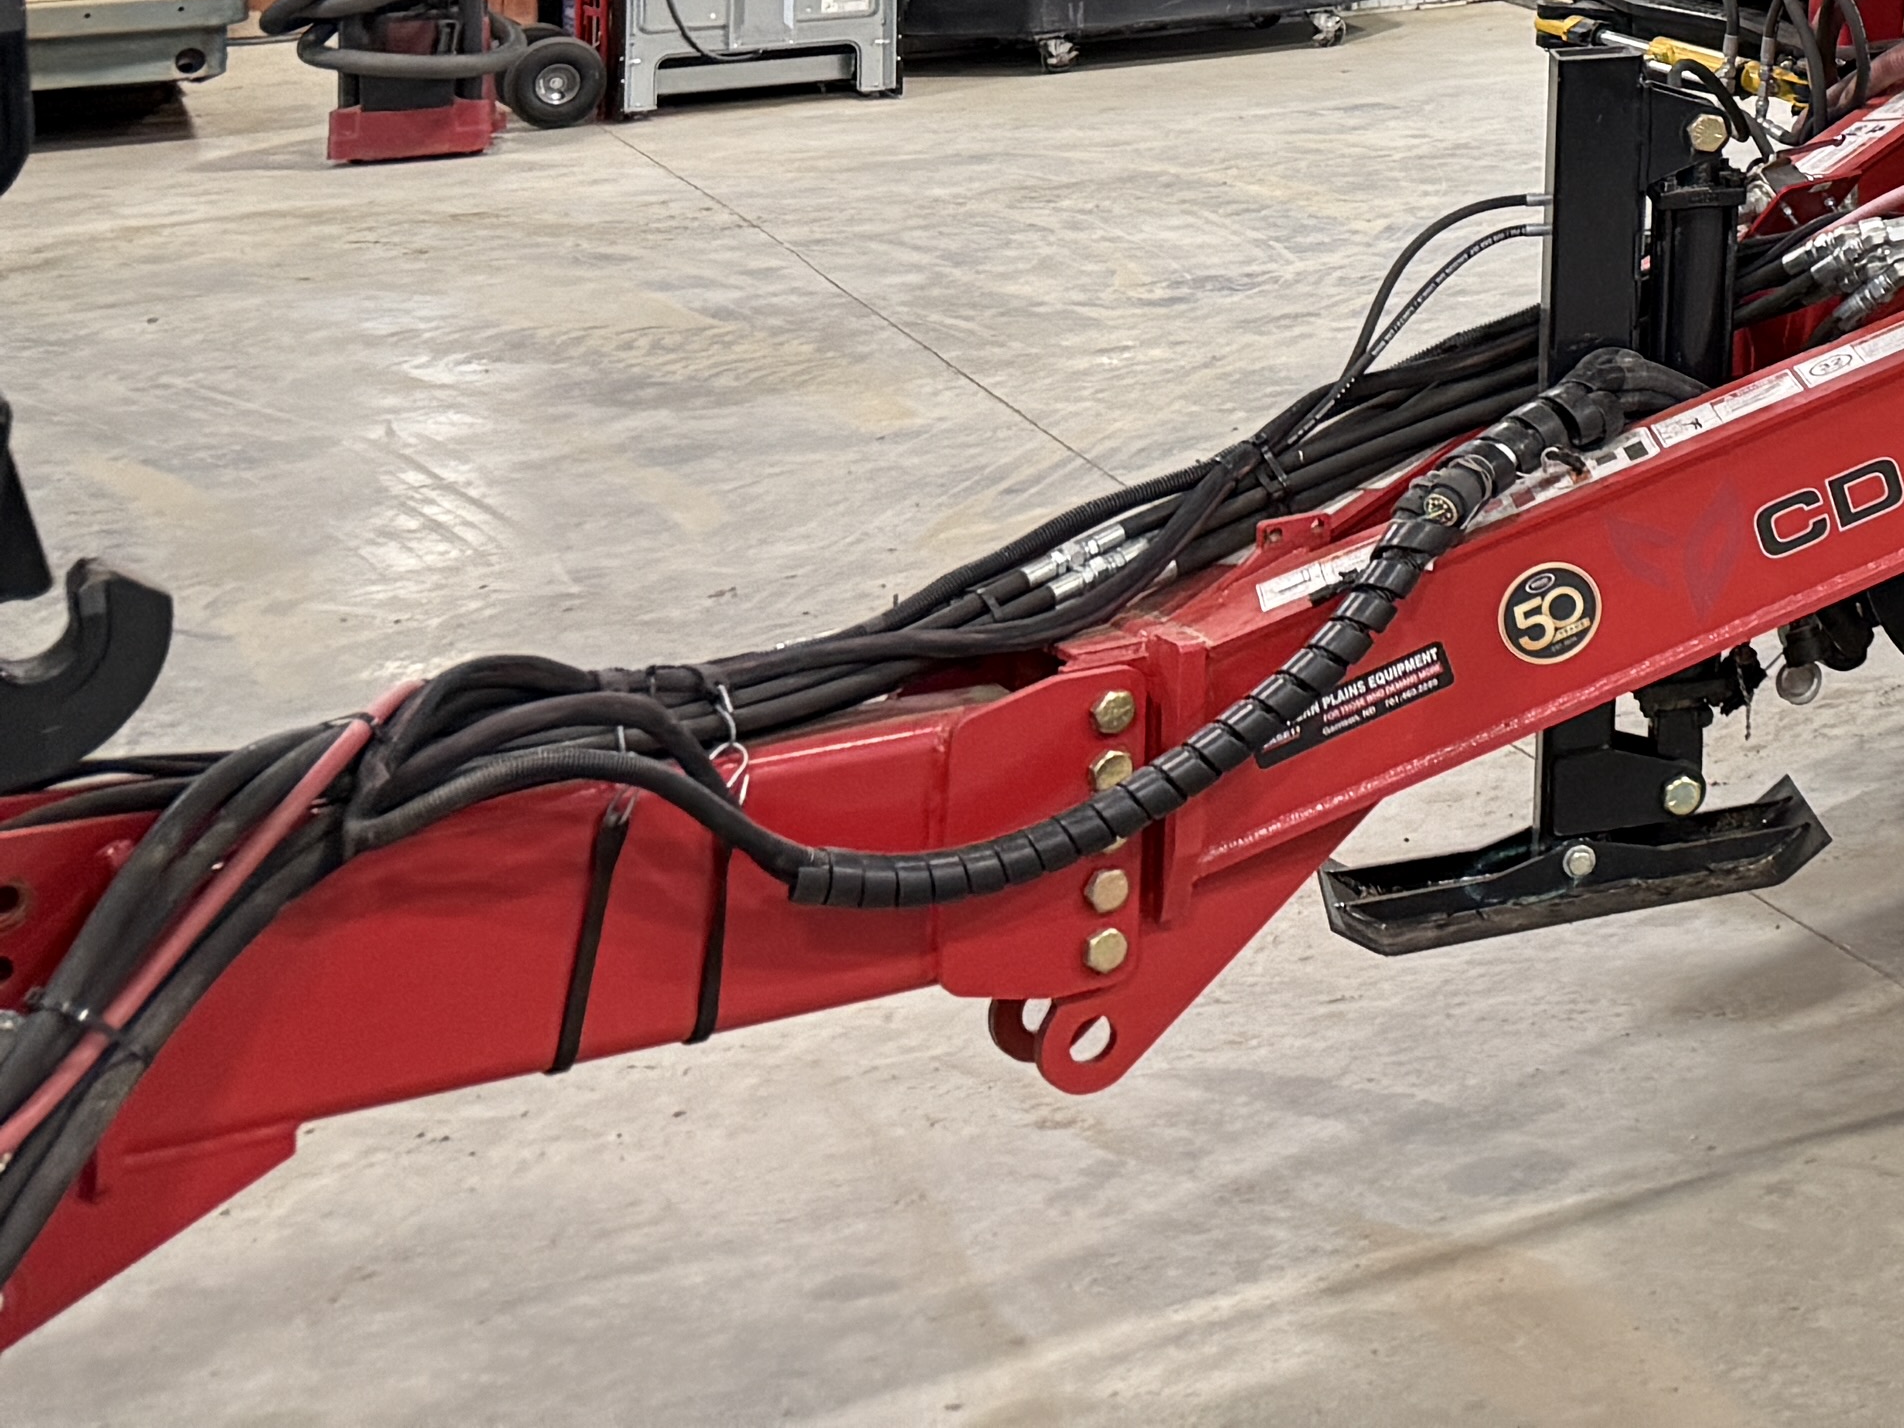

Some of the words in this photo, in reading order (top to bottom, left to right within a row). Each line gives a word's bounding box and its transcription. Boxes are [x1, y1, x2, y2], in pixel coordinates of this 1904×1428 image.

[1513, 586, 1584, 651] 50
[1322, 680, 1366, 710] PLAINS
[1368, 646, 1439, 688] EQUIPMENT
